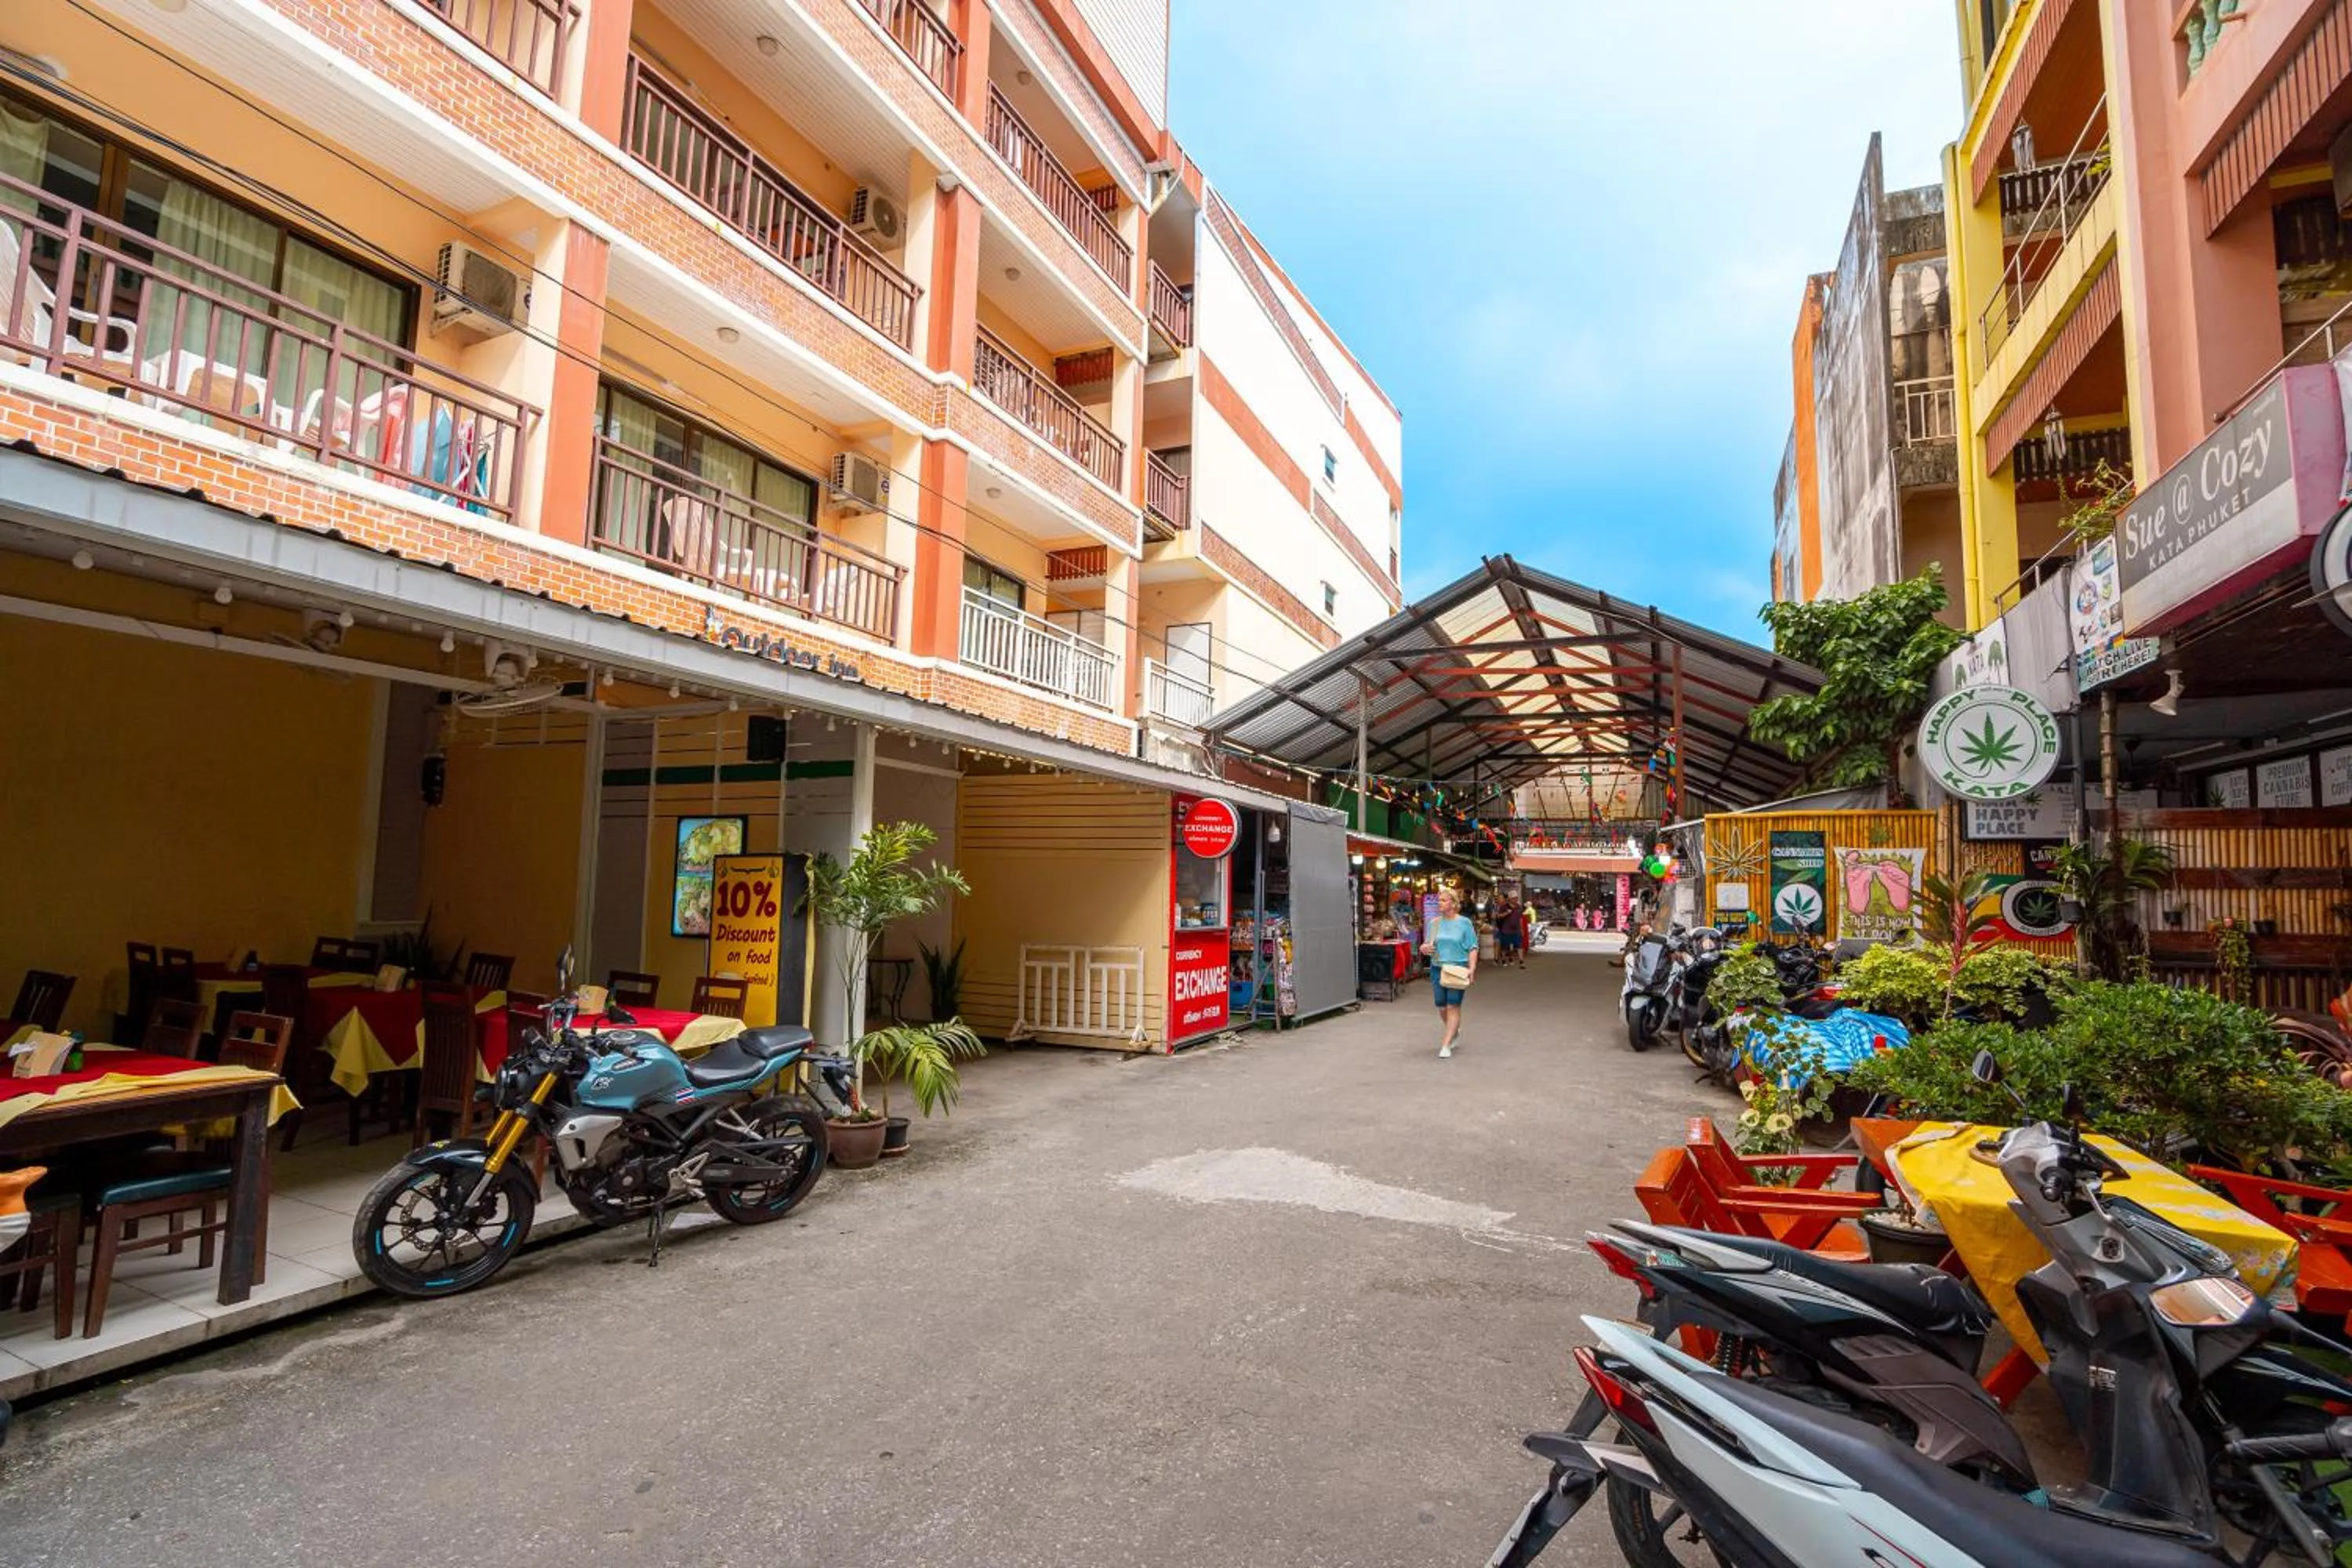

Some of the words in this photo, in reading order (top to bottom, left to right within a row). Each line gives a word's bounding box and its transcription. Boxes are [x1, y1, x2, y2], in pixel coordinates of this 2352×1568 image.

[2125, 506, 2166, 560] Sue
[2172, 474, 2193, 524] @
[2201, 419, 2271, 502] Cozy
[2149, 536, 2183, 571] KATA
[2188, 488, 2250, 543] PHUKET
[2125, 639, 2151, 657] LIVE
[2121, 649, 2151, 671] HERE!
[1926, 689, 1976, 744] HAPPY
[2011, 691, 2056, 753] PLACE
[1943, 771, 2030, 797] KATA
[2263, 775, 2310, 795] CANNABIS
[1976, 808, 2038, 822] HAPPY
[1185, 824, 1233, 833] EXCHANGE
[1976, 822, 2026, 835] PLACE
[716, 880, 777, 918] 10%
[715, 923, 776, 943] Discount
[727, 949, 741, 964] on
[746, 949, 772, 964] food
[1175, 966, 1227, 1001] EXCHANGE
